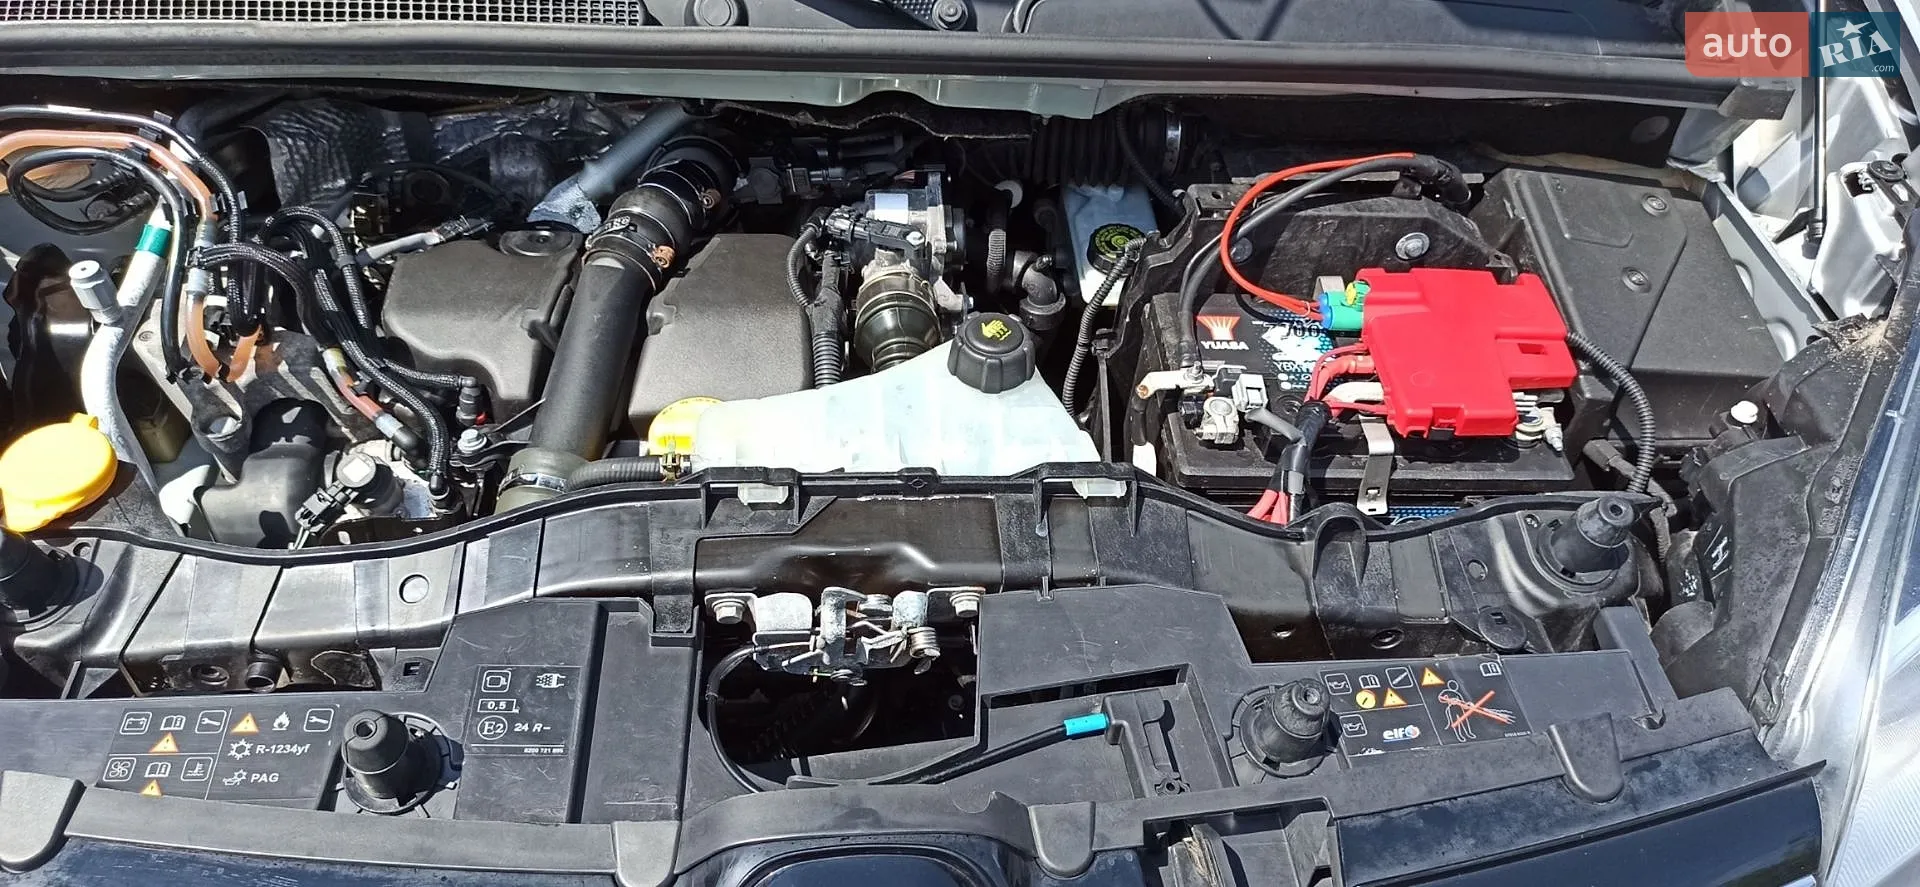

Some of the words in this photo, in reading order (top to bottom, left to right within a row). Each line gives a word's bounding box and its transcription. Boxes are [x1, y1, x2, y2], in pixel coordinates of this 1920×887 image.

[1200, 340, 1250, 351] YUASA
[487, 701, 507, 711] 0,5
[482, 721, 505, 735] E2
[513, 722, 530, 732] 24
[1383, 727, 1405, 739] elf
[255, 743, 311, 756] R-1234yf
[250, 772, 280, 783] PAG
